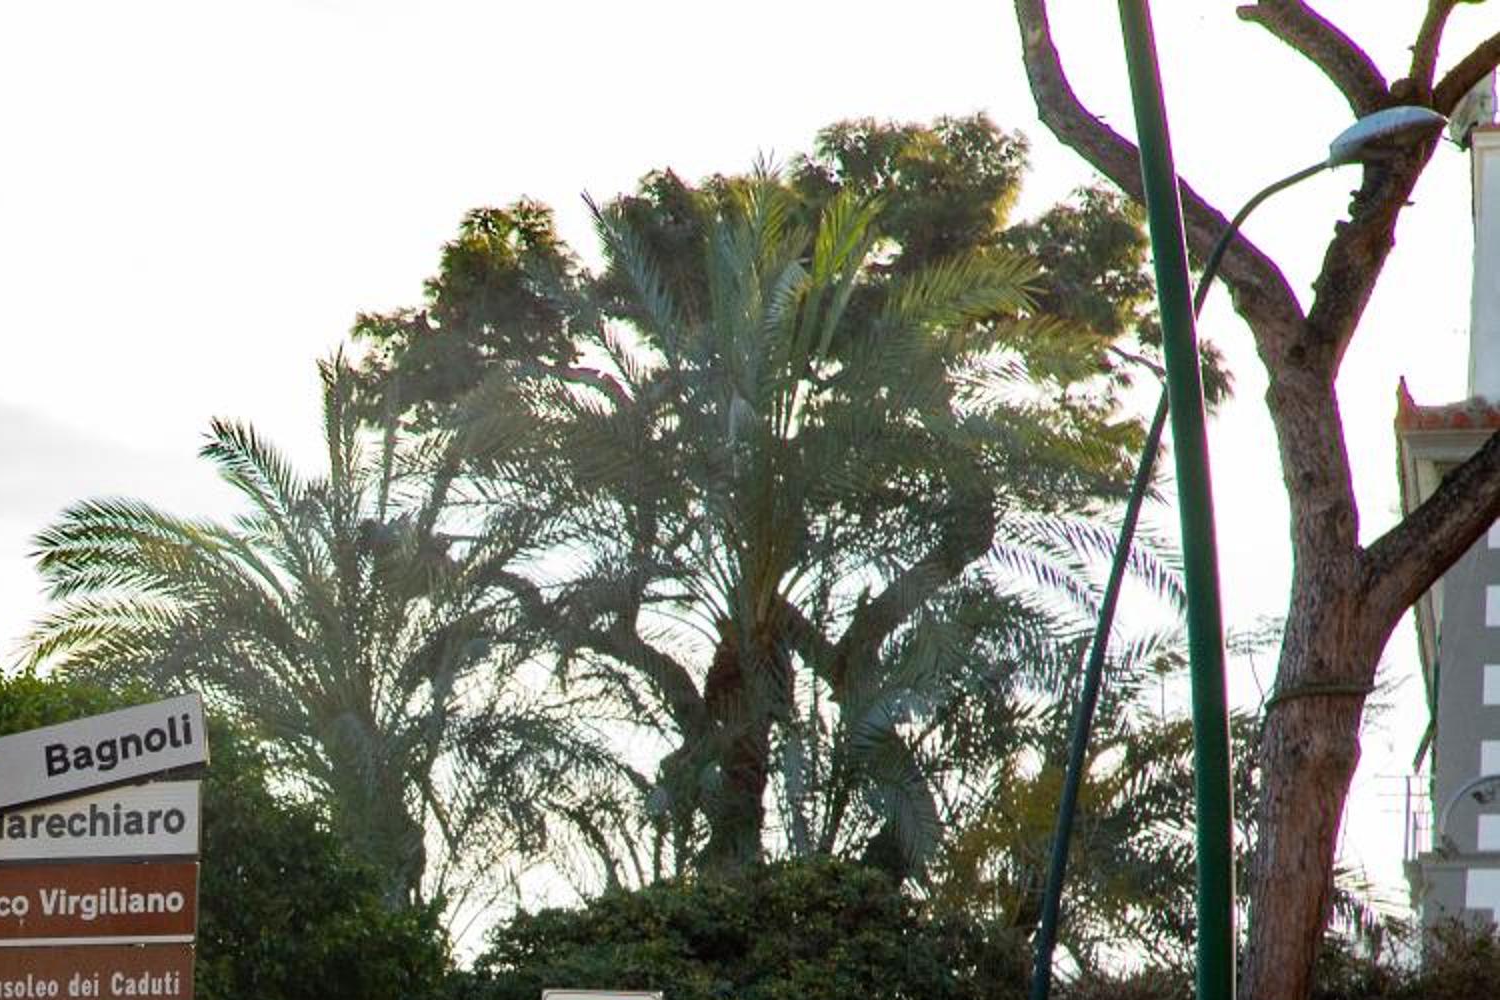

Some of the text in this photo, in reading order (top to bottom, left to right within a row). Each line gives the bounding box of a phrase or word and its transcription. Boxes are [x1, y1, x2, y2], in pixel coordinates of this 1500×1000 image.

[44, 712, 194, 778] Bagnoli
[39, 887, 185, 922] Virgiliano
[68, 973, 100, 998] dei
[111, 971, 180, 996] Caduti
